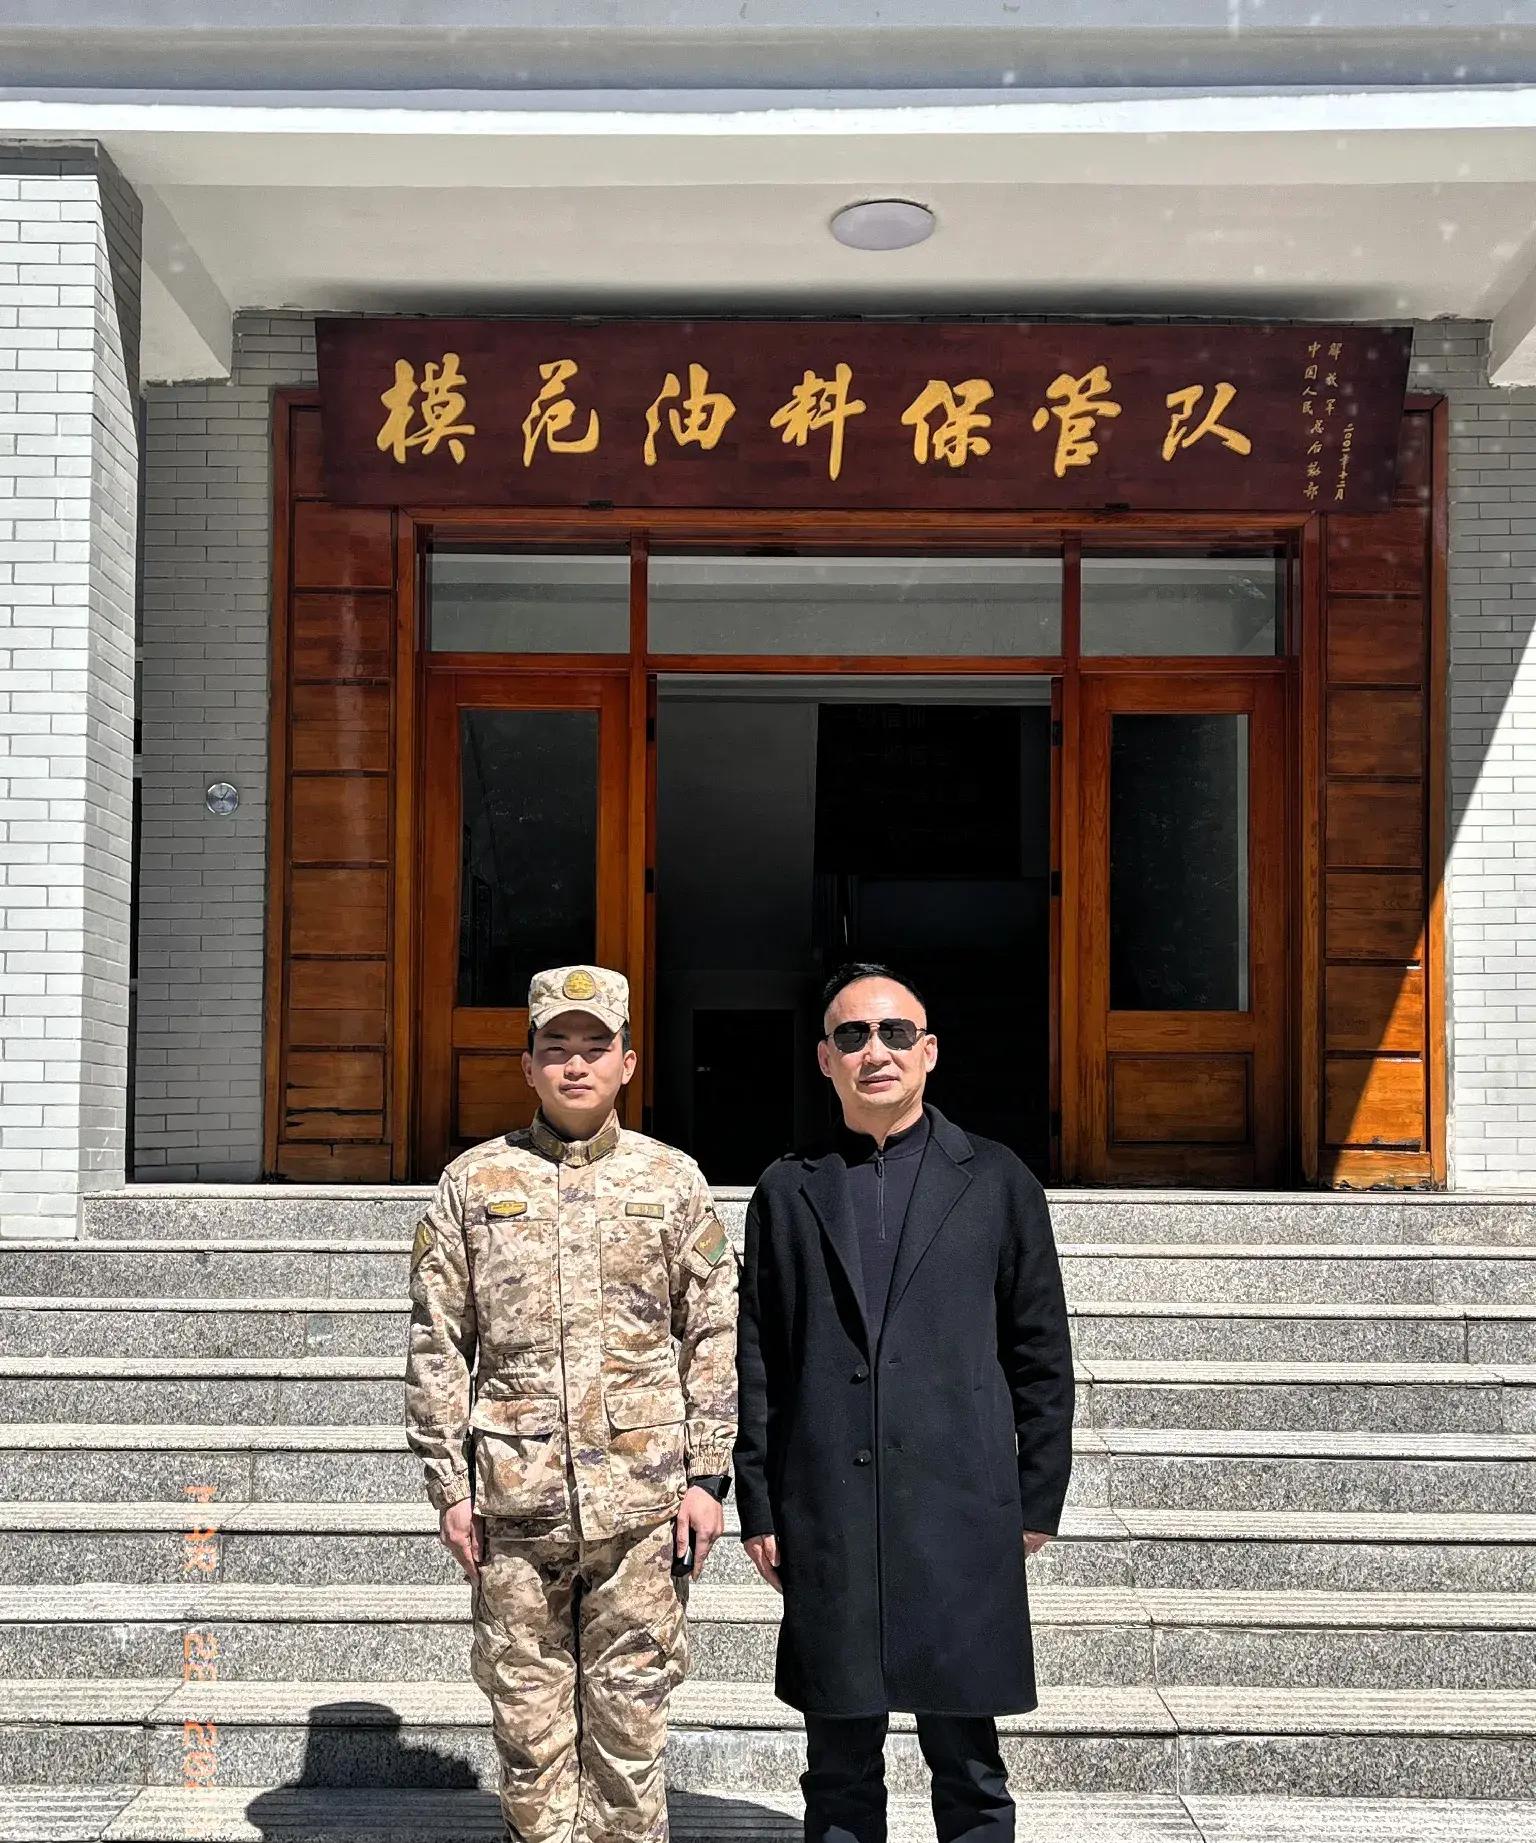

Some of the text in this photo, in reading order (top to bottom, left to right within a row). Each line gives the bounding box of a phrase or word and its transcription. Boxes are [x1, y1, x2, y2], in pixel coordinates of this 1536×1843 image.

[376, 353, 1252, 481] 模范油料保管队
